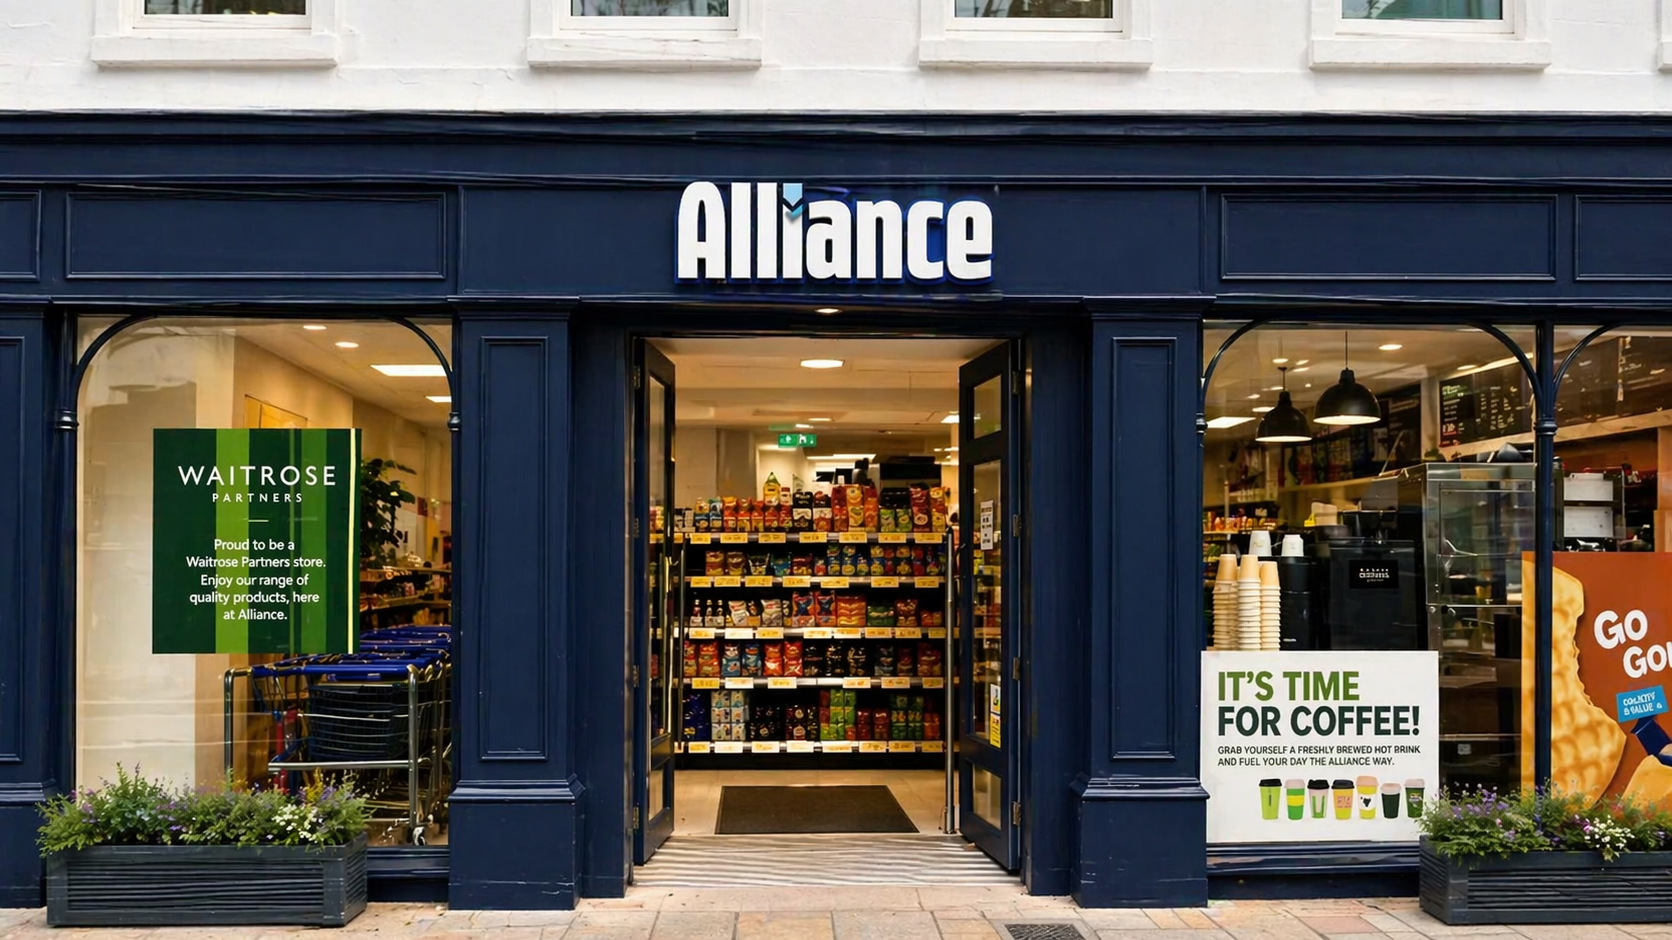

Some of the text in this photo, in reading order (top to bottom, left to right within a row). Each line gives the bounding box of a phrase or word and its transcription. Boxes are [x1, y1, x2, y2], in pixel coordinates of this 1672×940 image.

[677, 181, 993, 279] Alliance
[179, 466, 335, 485] WAITROSE
[213, 493, 301, 502] PARTNERS
[215, 539, 294, 550] Proud to be a
[186, 556, 325, 567] Waitrose Partners store.
[201, 574, 308, 588] Enjoy our range of
[190, 591, 319, 605] quality products, here
[224, 609, 287, 619] at Alliance.
[1594, 610, 1648, 649] GO
[1219, 671, 1359, 701] IT’S TIME
[1219, 706, 1419, 736] FOR COFFEE!
[1218, 746, 1242, 754] GRAB
[1245, 746, 1287, 754] YOURSELF
[1298, 746, 1334, 754] FRESHLY
[1337, 746, 1372, 754] BREWED
[1218, 758, 1236, 766] AND
[1240, 758, 1260, 766] FUEL
[1310, 757, 1326, 765] THE
[1329, 757, 1370, 765] ALLIANCE
